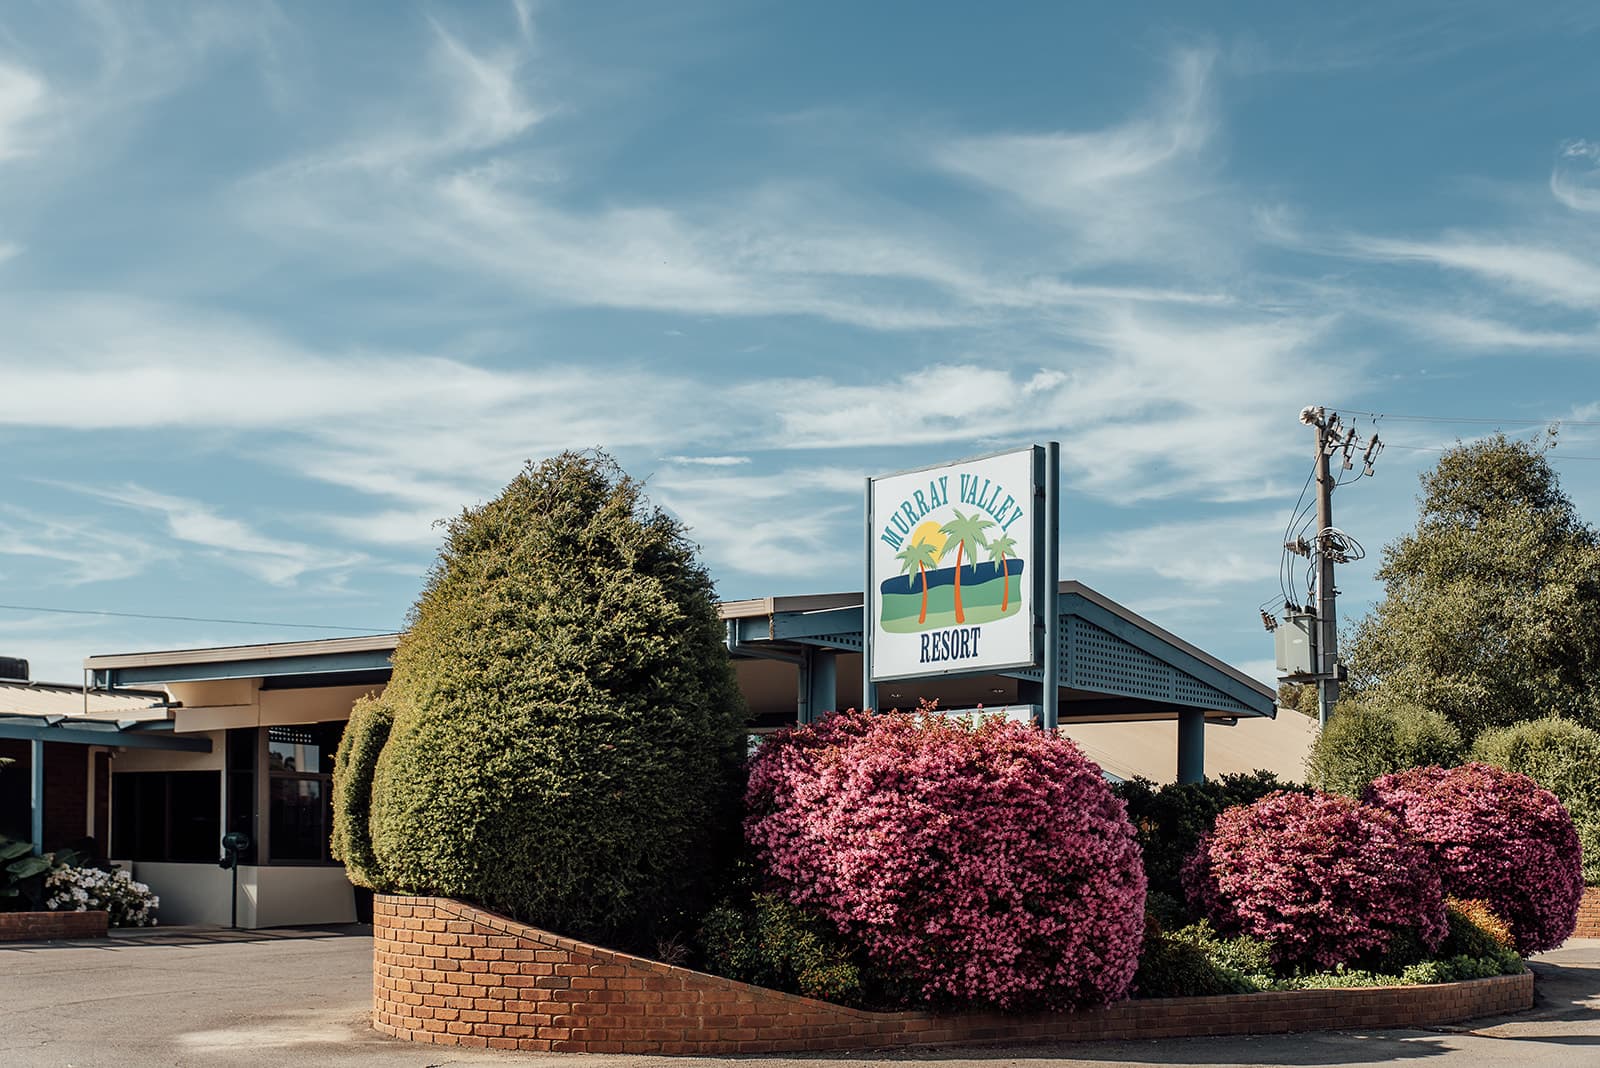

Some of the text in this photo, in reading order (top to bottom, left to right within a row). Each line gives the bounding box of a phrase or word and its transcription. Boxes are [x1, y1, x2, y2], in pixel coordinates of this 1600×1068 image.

[881, 474, 1023, 551] MURRAY VALLEY
[920, 627, 981, 663] RESORT
